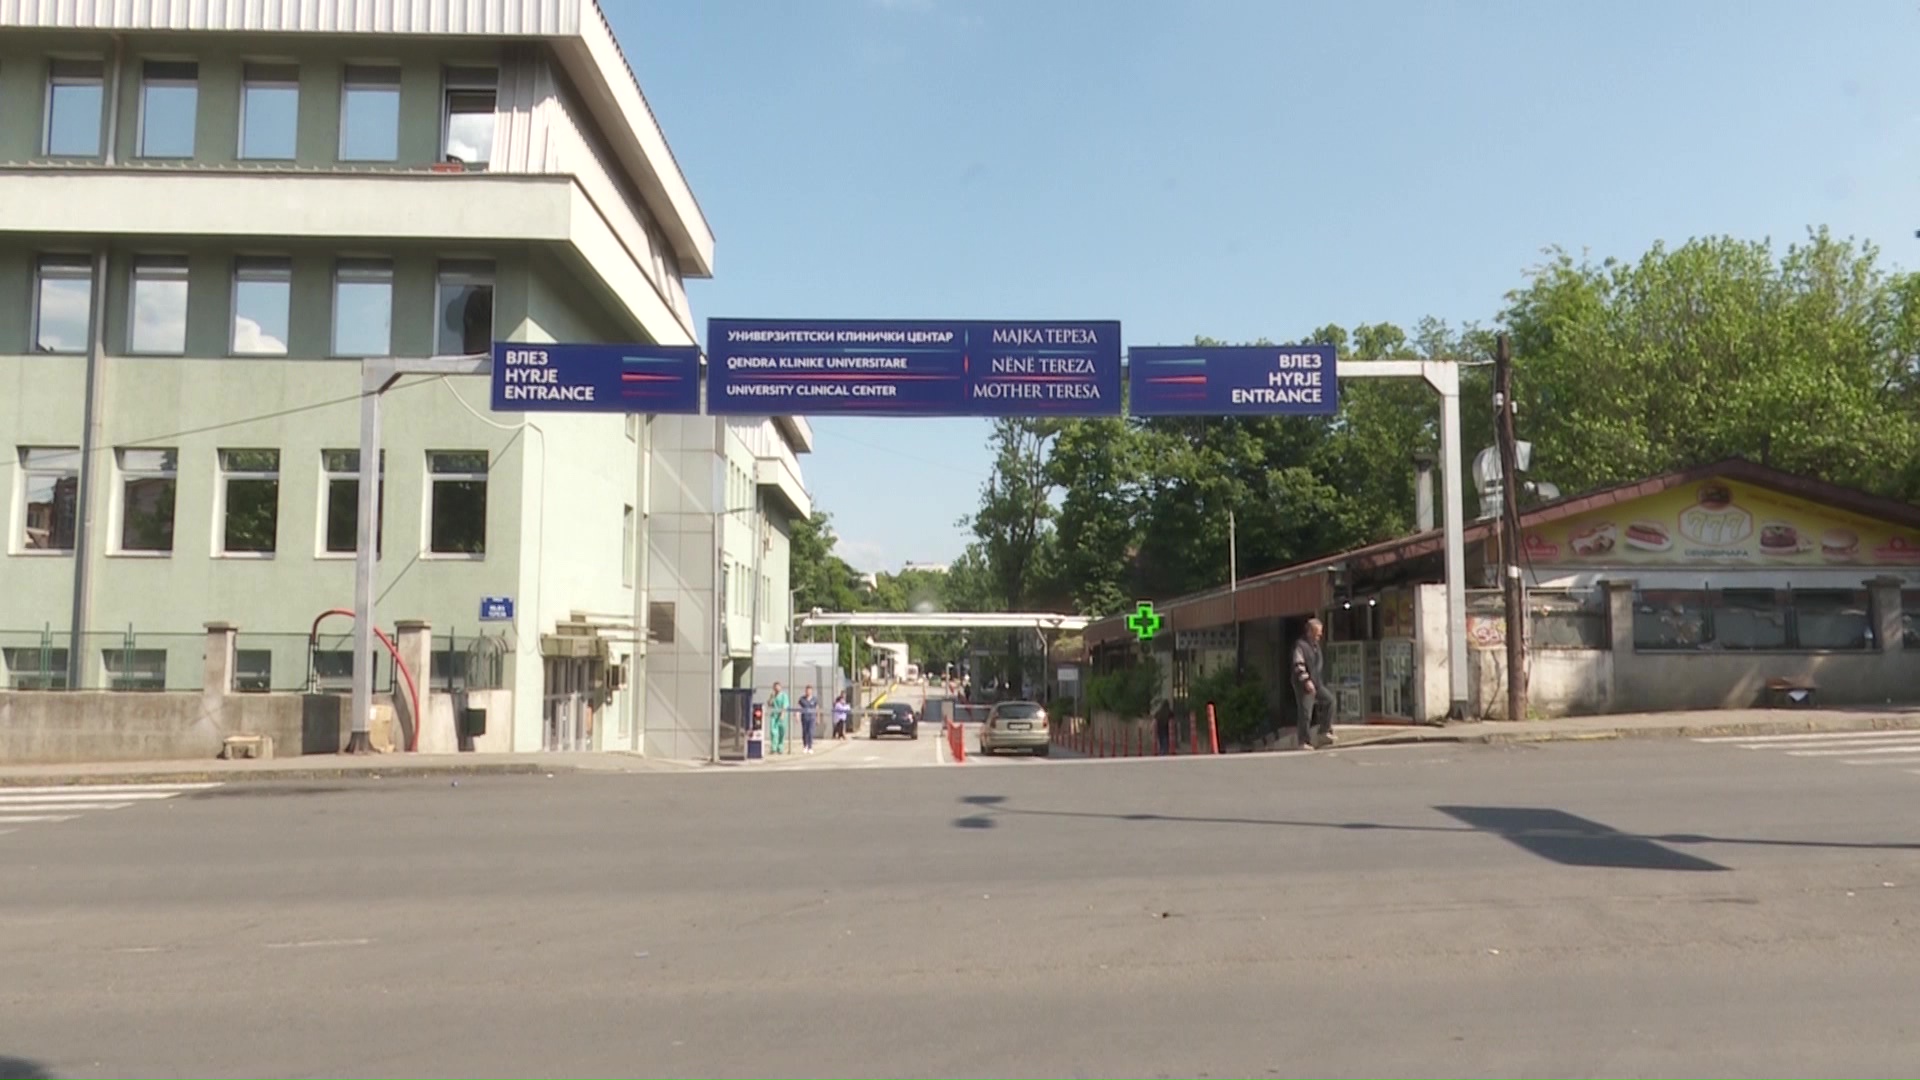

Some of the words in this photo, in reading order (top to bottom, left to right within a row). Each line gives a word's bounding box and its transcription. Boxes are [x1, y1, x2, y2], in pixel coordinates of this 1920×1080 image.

[728, 331, 834, 342] УНИВЕРЗИТЕТСКИ
[836, 331, 905, 342] КЛИНИЧКИ
[908, 331, 953, 343] ЦЕНТАР
[993, 329, 1043, 346] МАЈКА
[1045, 329, 1098, 344] ТЕРЕЗА
[505, 351, 548, 365] ВЛЕЗ
[727, 357, 777, 369] QENDRA
[779, 357, 824, 368] KLINIKE
[827, 358, 907, 369] UNIVERSITARE
[992, 356, 1035, 373] NËNË
[1039, 359, 1096, 373] TEREZA
[1279, 354, 1322, 369] ВЛЕЗ
[504, 368, 558, 383] HYRJE
[1269, 372, 1322, 386] HYRJE
[504, 386, 594, 401] ENTRANCE
[726, 385, 794, 396] UNIVERSITY
[796, 385, 850, 396] CLINICAL
[852, 385, 897, 396] CENTER
[973, 383, 1042, 398] MOTHER
[1046, 384, 1101, 399] TERESA
[1232, 389, 1322, 404] ENTRANCE
